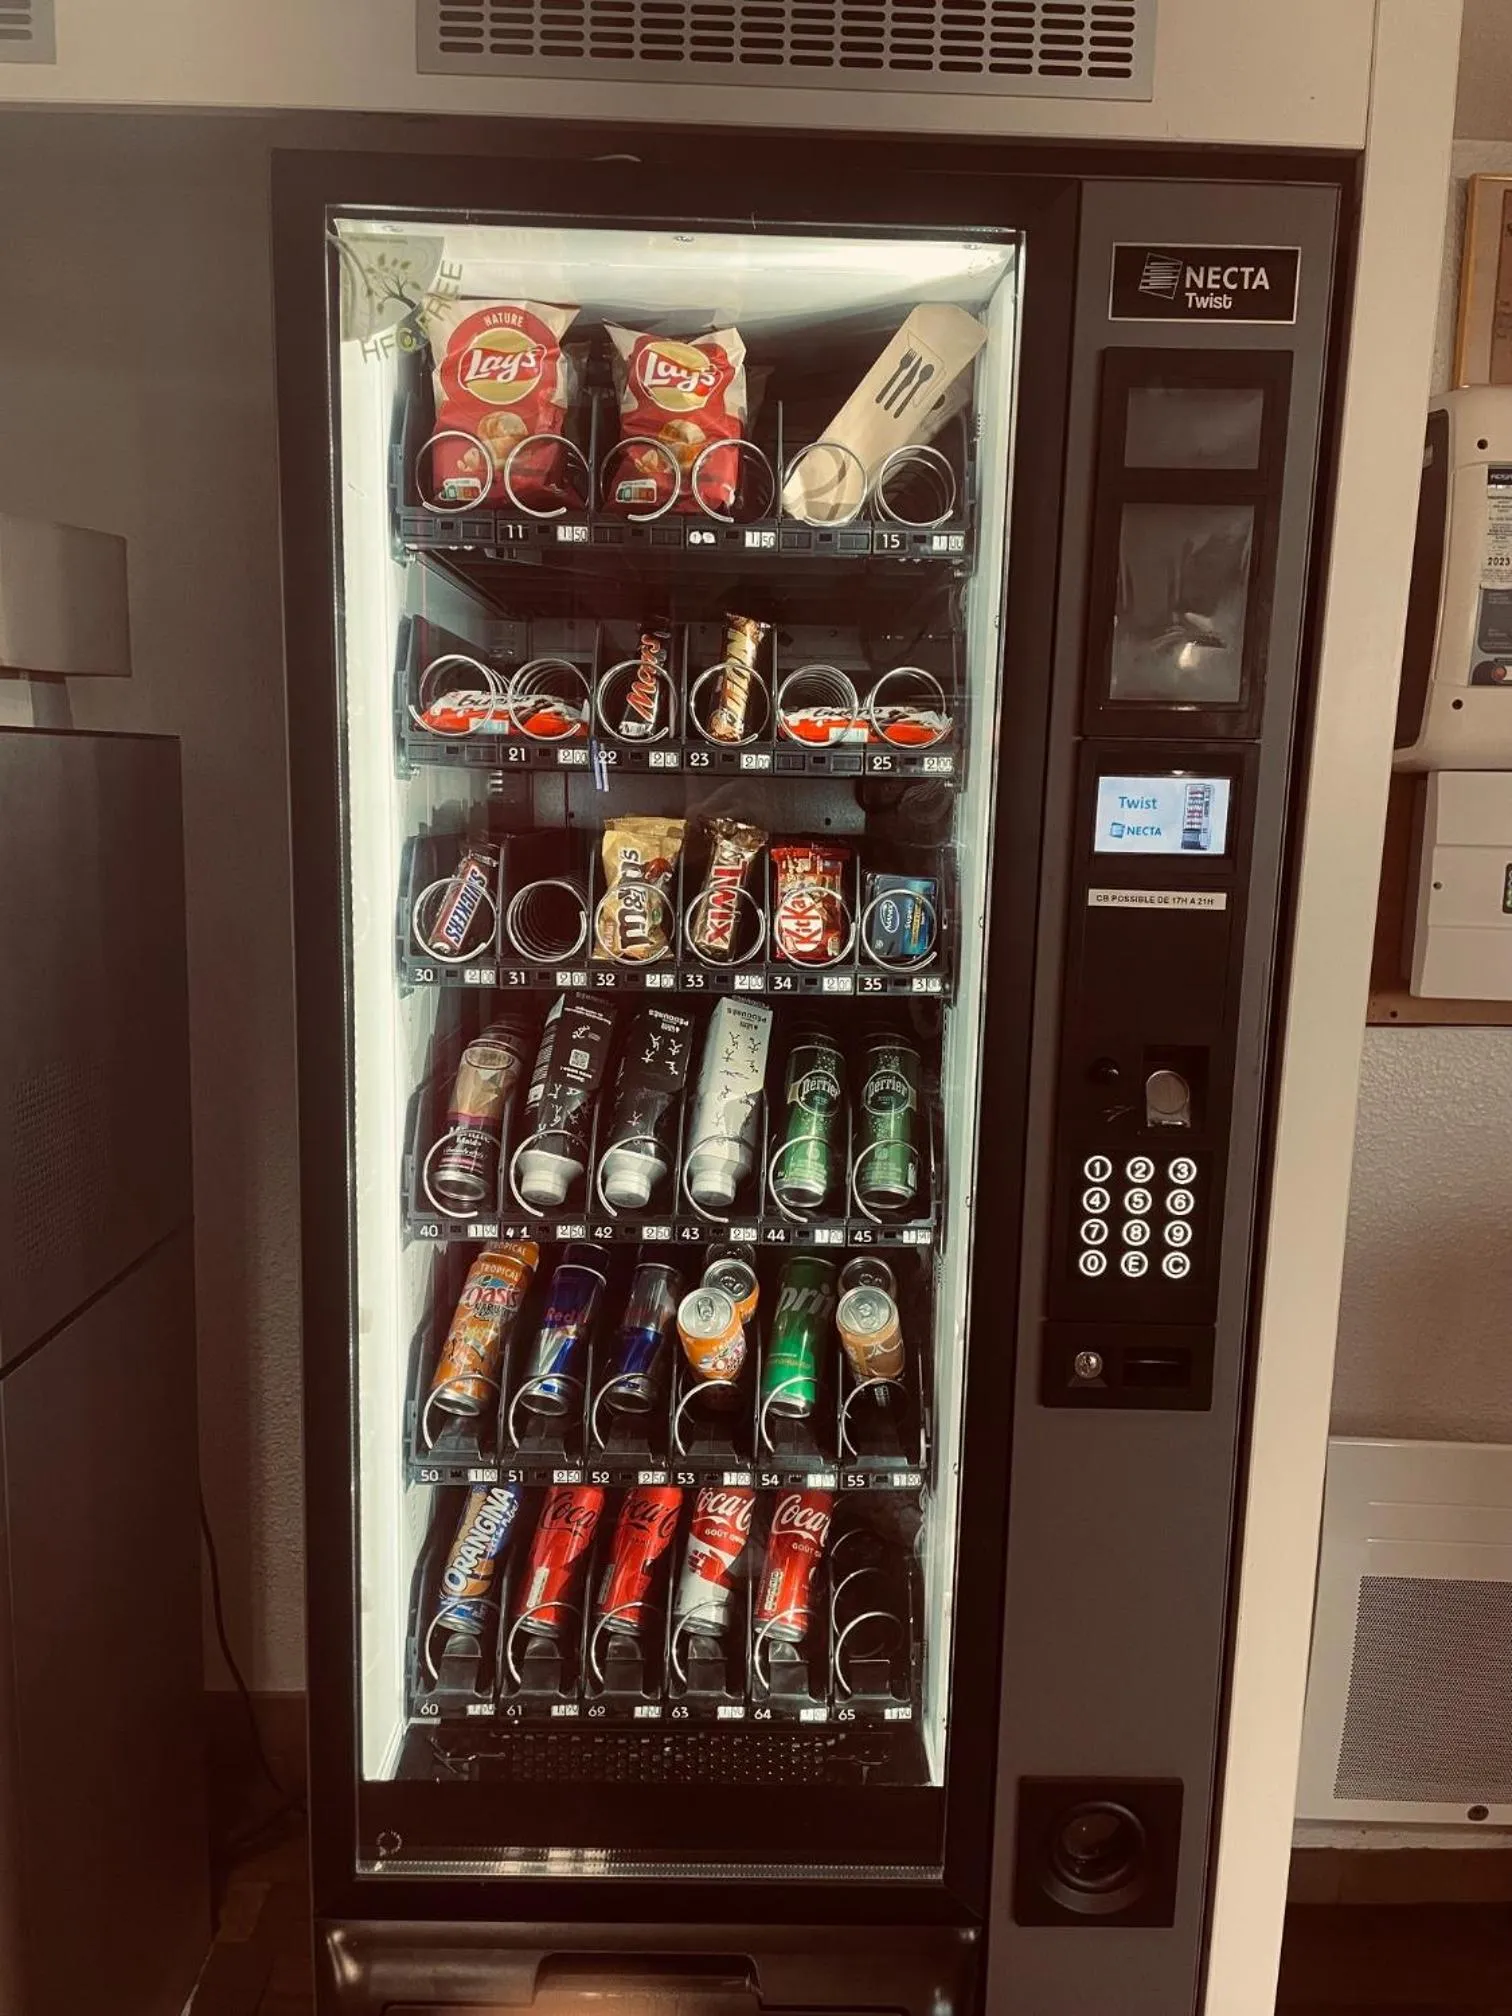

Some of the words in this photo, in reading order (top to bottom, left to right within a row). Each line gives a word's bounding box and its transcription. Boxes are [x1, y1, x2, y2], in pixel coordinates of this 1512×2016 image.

[1184, 266, 1270, 290] NECTA
[1185, 292, 1233, 309] Twist
[483, 312, 524, 327] NATURE
[507, 525, 523, 538] 11
[883, 535, 900, 549] 15
[1487, 557, 1511, 566] 2023
[626, 633, 660, 723] Mars
[508, 748, 526, 761] 21
[598, 751, 616, 764] 22
[690, 753, 709, 766] 23
[873, 757, 892, 770] 25
[1119, 796, 1158, 810] Twist
[1126, 826, 1162, 836] NECTA
[1096, 894, 1109, 903] CB
[1111, 895, 1155, 904] POSSIBLE
[1156, 896, 1169, 904] DE
[1172, 897, 1187, 905] 17H
[446, 867, 488, 947] SNICKERS
[415, 969, 434, 982] 30
[509, 972, 526, 985] 31
[596, 973, 616, 986] 32
[685, 975, 704, 988] 33
[773, 976, 792, 990] 34
[863, 977, 882, 991] 35
[801, 1078, 842, 1102] Perrier
[867, 1077, 909, 1104] Perrier
[420, 1225, 438, 1238] 40
[594, 1226, 613, 1239] 42
[682, 1227, 700, 1240] 43
[767, 1228, 785, 1242] 44
[854, 1230, 872, 1243] 45
[481, 1262, 520, 1280] TROPICAL
[420, 1469, 439, 1482] 50
[508, 1469, 525, 1482] 51
[592, 1471, 610, 1484] 52
[677, 1472, 695, 1484] 53
[761, 1474, 779, 1485] 54
[848, 1475, 865, 1487] 55
[444, 1486, 514, 1593] ORANGINA
[420, 1703, 438, 1715] 60
[507, 1705, 522, 1716] 61
[588, 1705, 606, 1717] 62
[672, 1707, 689, 1719] 63
[754, 1708, 771, 1720] 64
[838, 1709, 855, 1721] 65
